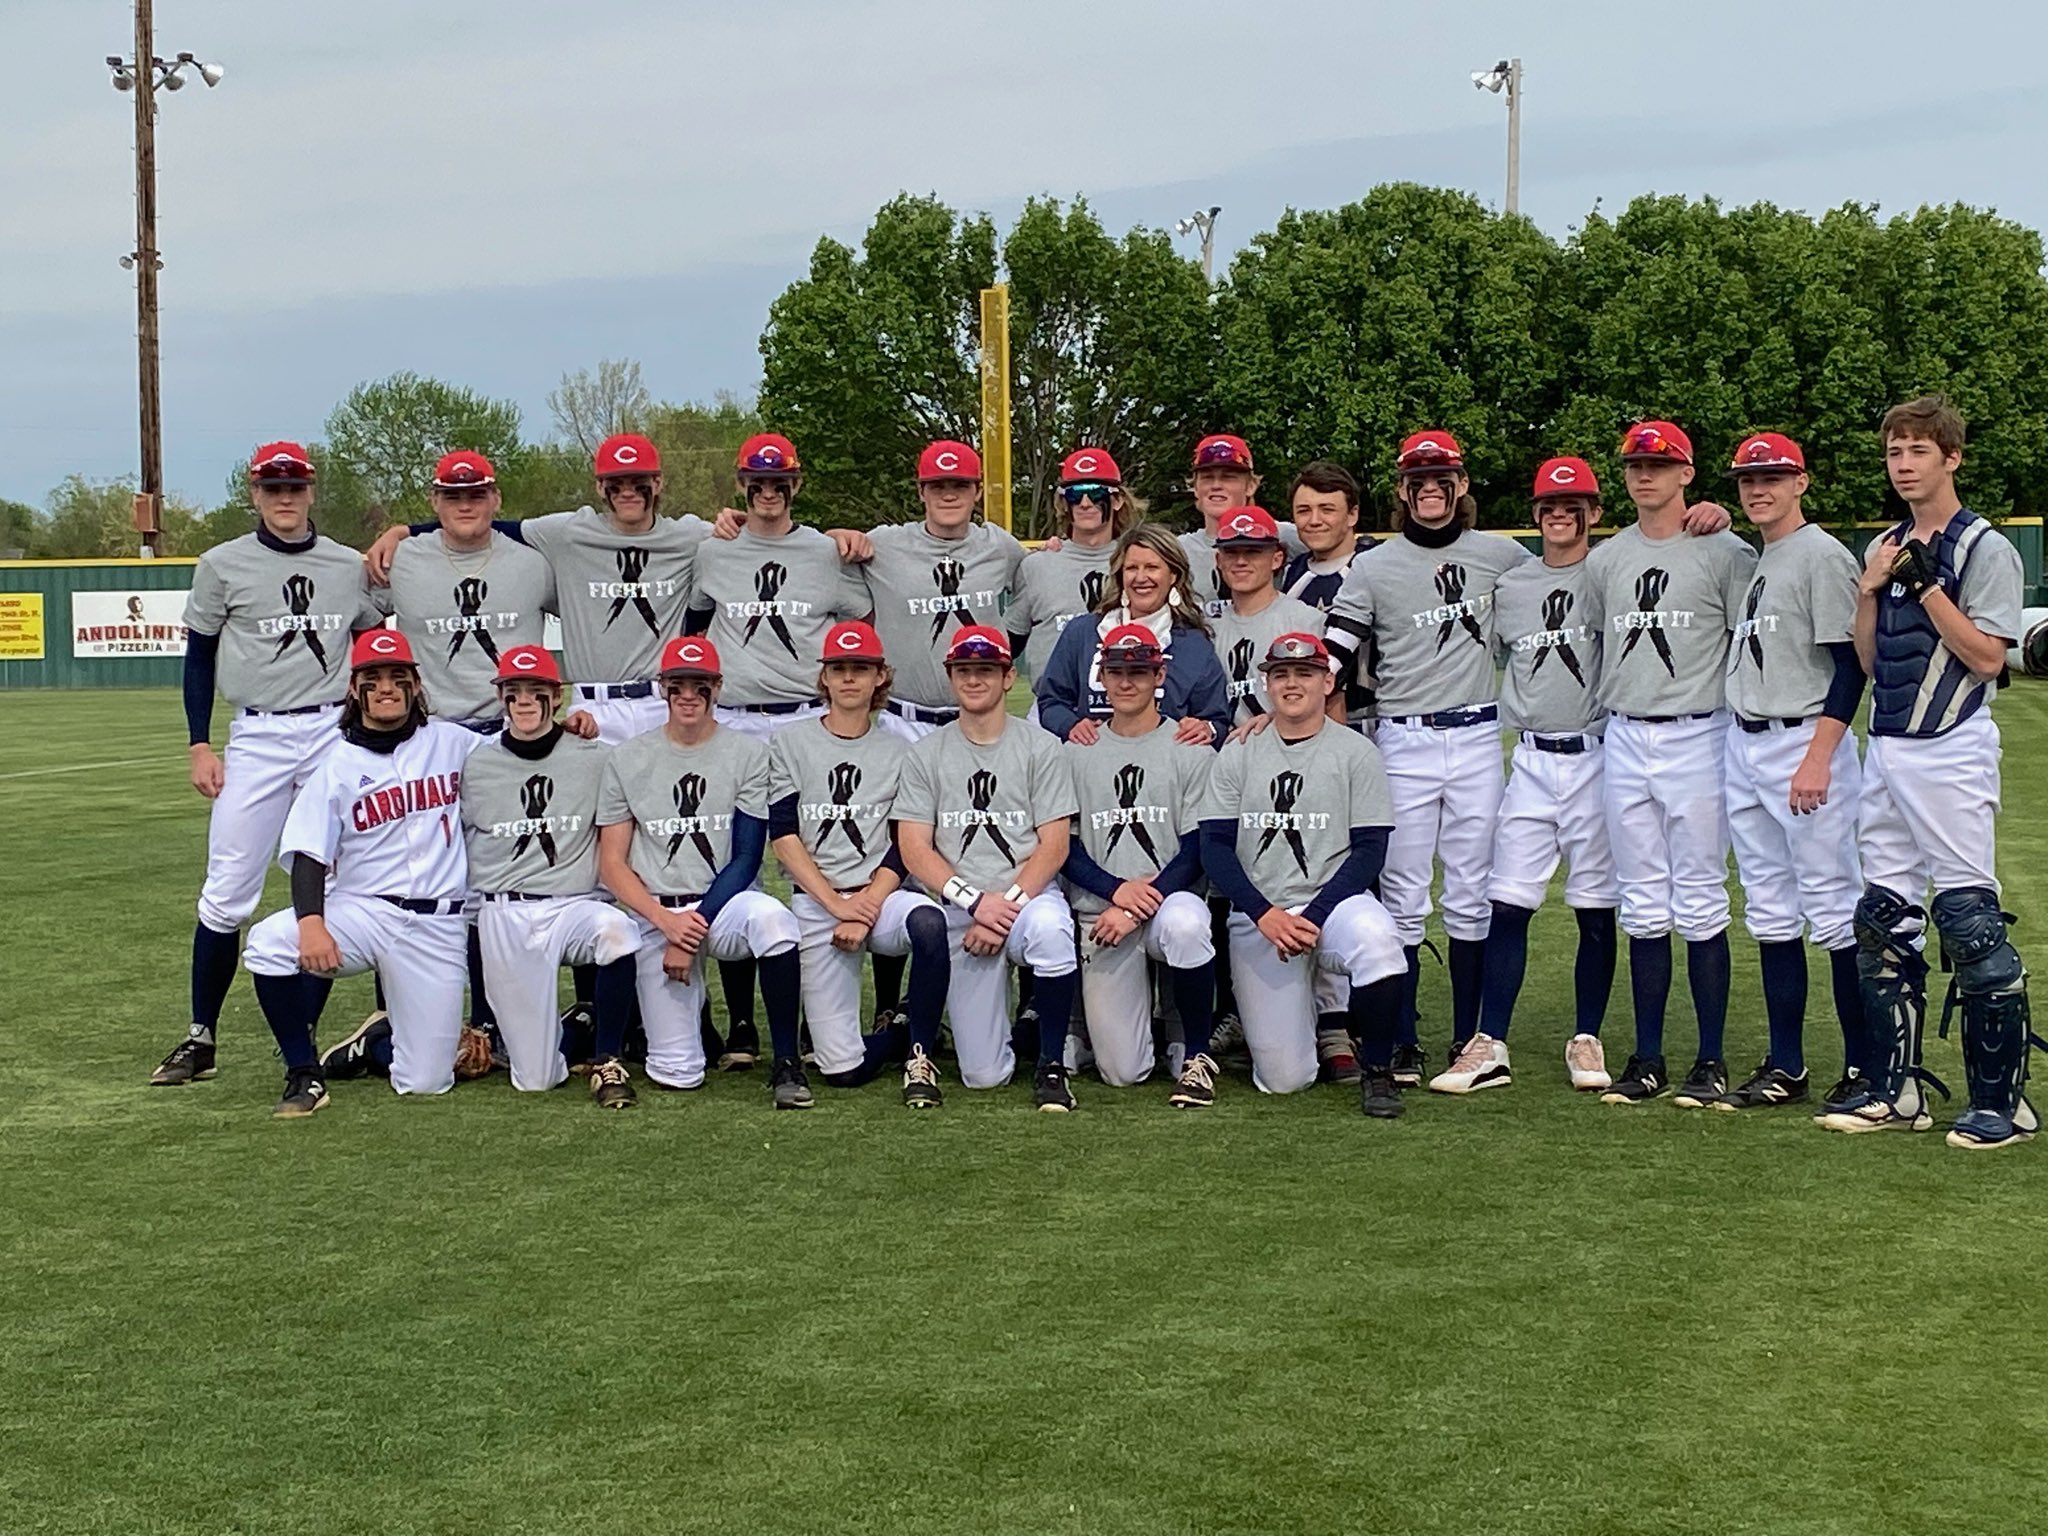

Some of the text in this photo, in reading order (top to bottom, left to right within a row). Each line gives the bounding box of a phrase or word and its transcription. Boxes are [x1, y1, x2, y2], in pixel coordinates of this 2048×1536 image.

[588, 580, 676, 598] FIGHT IT
[726, 601, 812, 618] FIGHT IT
[907, 590, 994, 614] FIGHT IT
[257, 614, 342, 635] FIGHT IT
[425, 613, 518, 635] FIGHT IT
[1412, 600, 1475, 628] FIGHT
[1613, 610, 1695, 632] FGHT IT
[77, 625, 189, 642] ANDOLINI'S
[108, 643, 163, 653] PIZZERIA
[352, 772, 459, 832] CARDINALS
[801, 803, 861, 821] FIGHT
[492, 815, 582, 838] FIGHT IT
[645, 816, 708, 836] FIGHT
[941, 810, 1026, 828] FIGHT IT
[1091, 806, 1168, 830] FIGHT IT
[1242, 812, 1330, 830] FIGHT IT
[440, 813, 451, 848] 1
